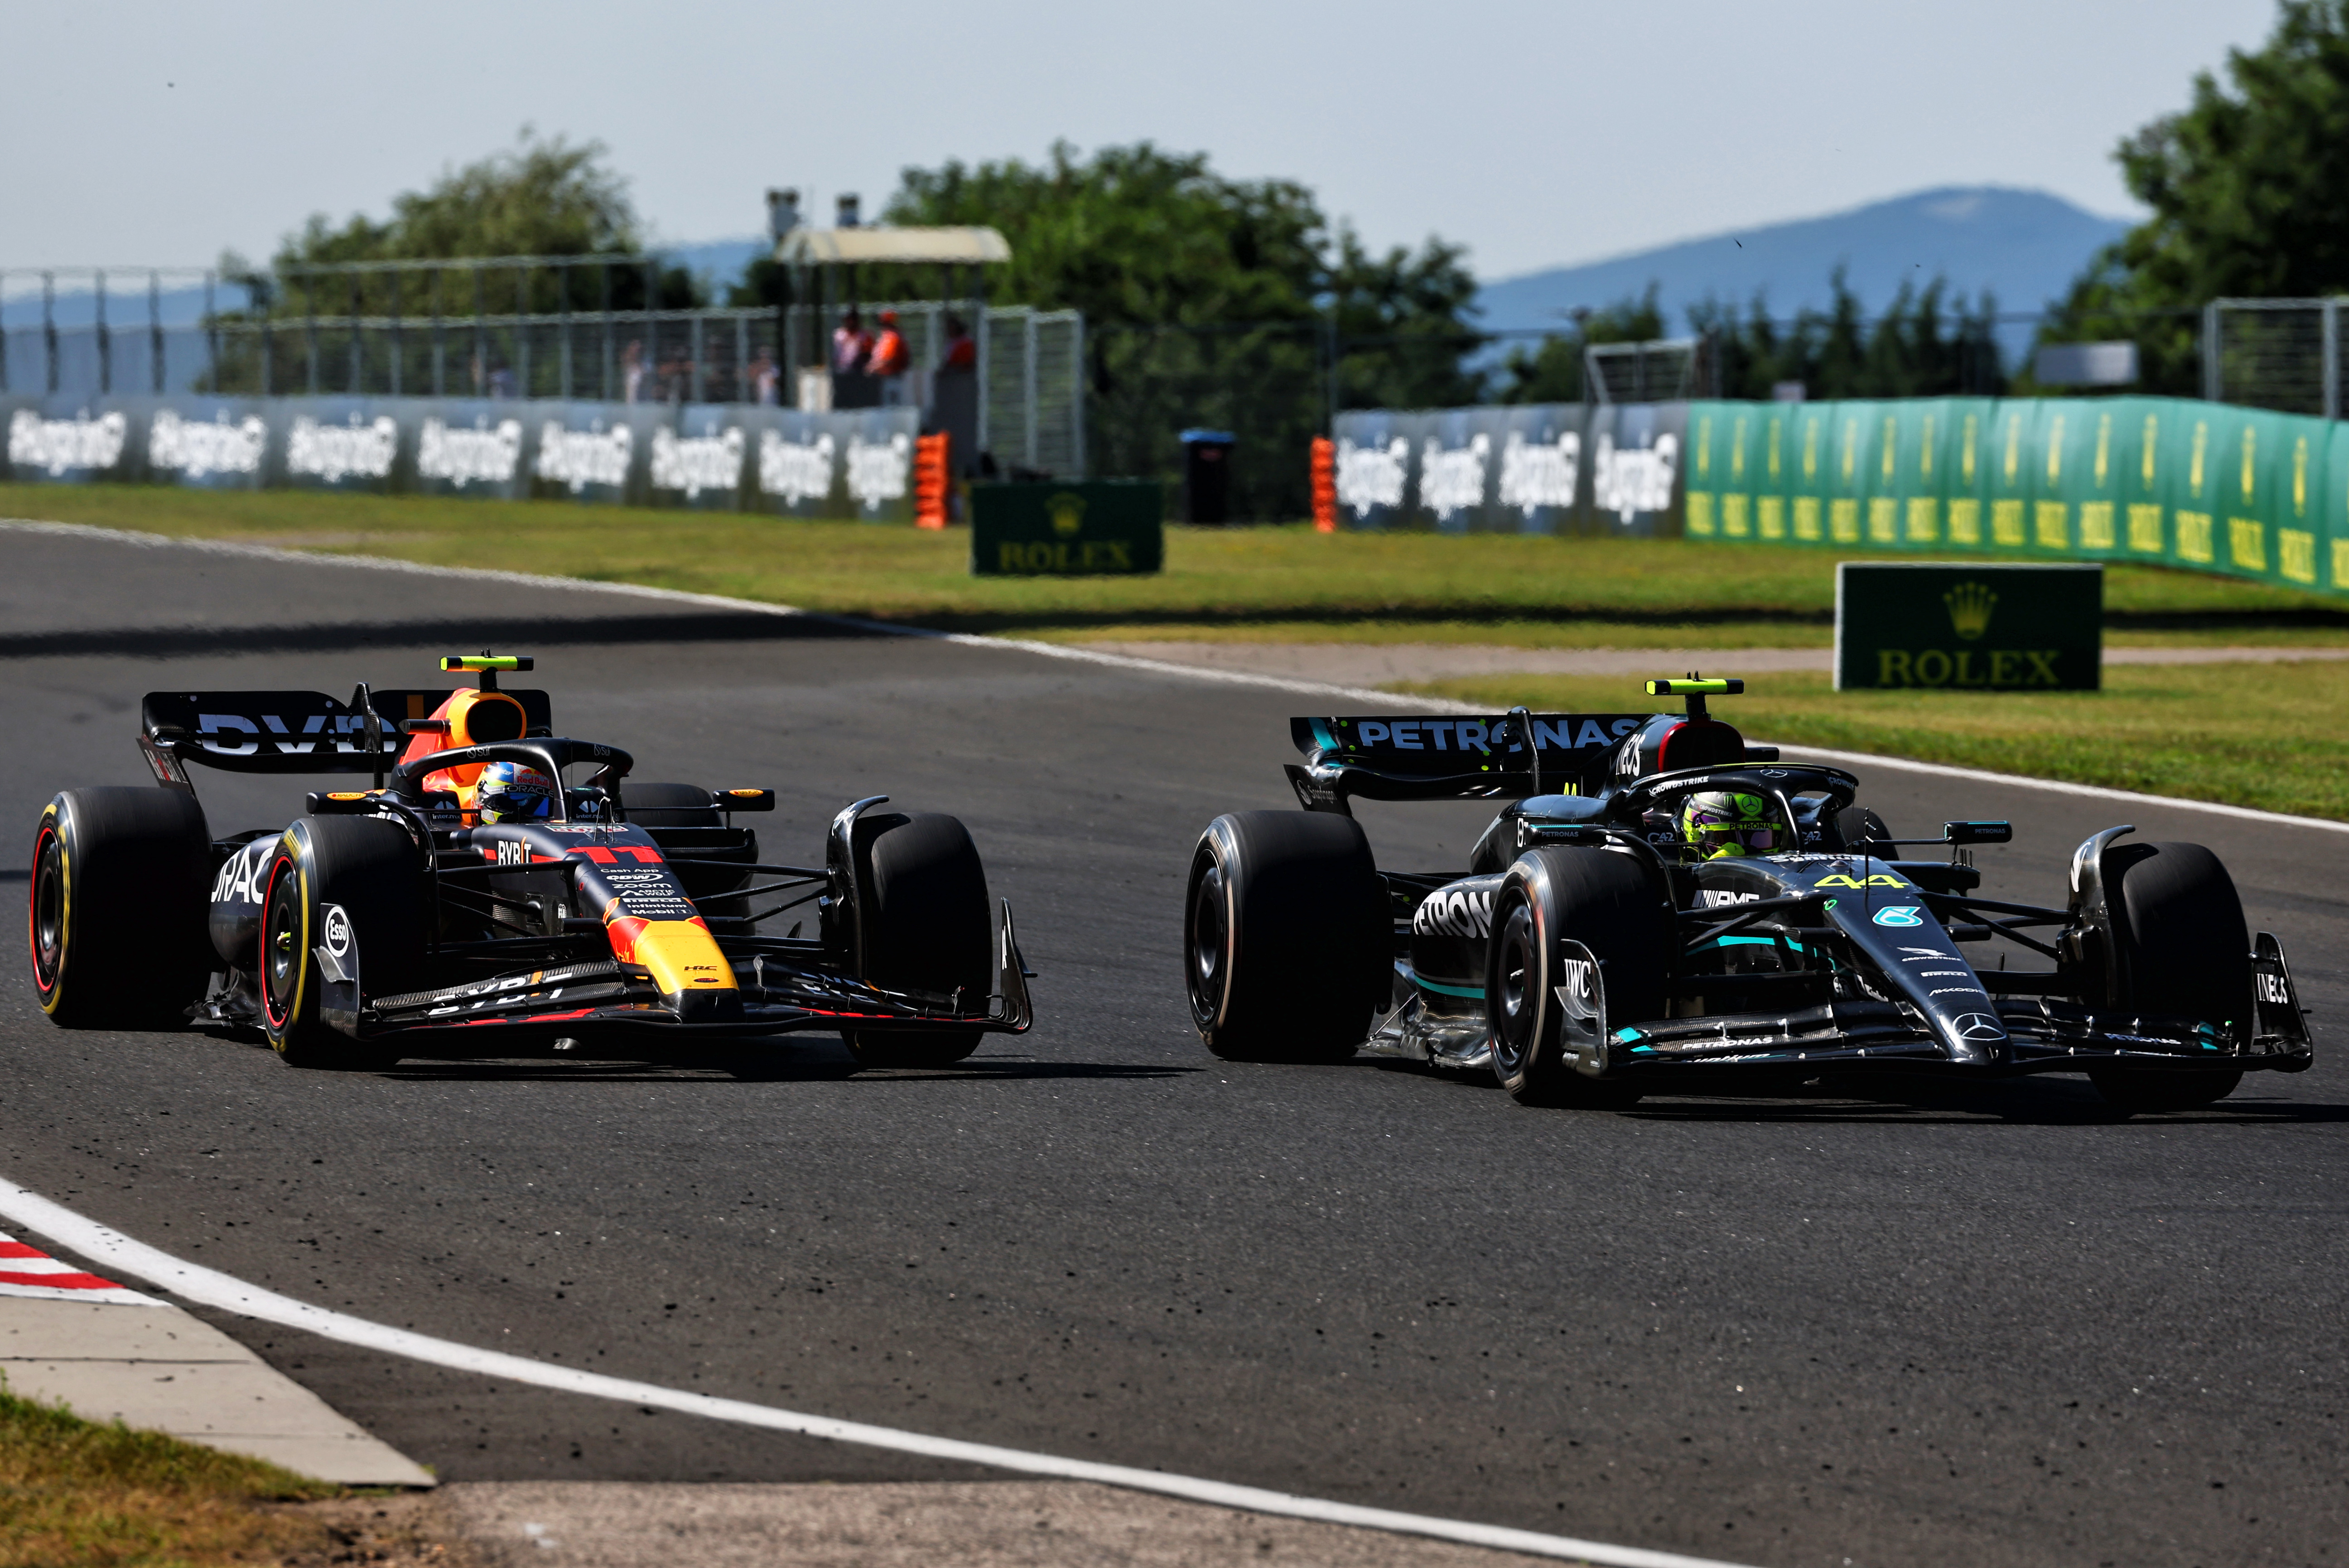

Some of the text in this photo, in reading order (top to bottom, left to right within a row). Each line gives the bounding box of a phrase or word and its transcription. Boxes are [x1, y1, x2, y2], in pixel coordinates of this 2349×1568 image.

[1878, 649, 2060, 685] ROLEX
[477, 747, 490, 756] Sui
[535, 777, 548, 787] Bull
[1652, 775, 1709, 794] CROWDSTRIKE
[507, 785, 554, 798] ORACLE
[1699, 804, 1733, 817] CROWDSTRIKE
[565, 846, 664, 863] 11
[1814, 874, 1910, 889] 44
[1564, 958, 1591, 999] IWC
[1682, 1037, 1774, 1050] PETRONAS
